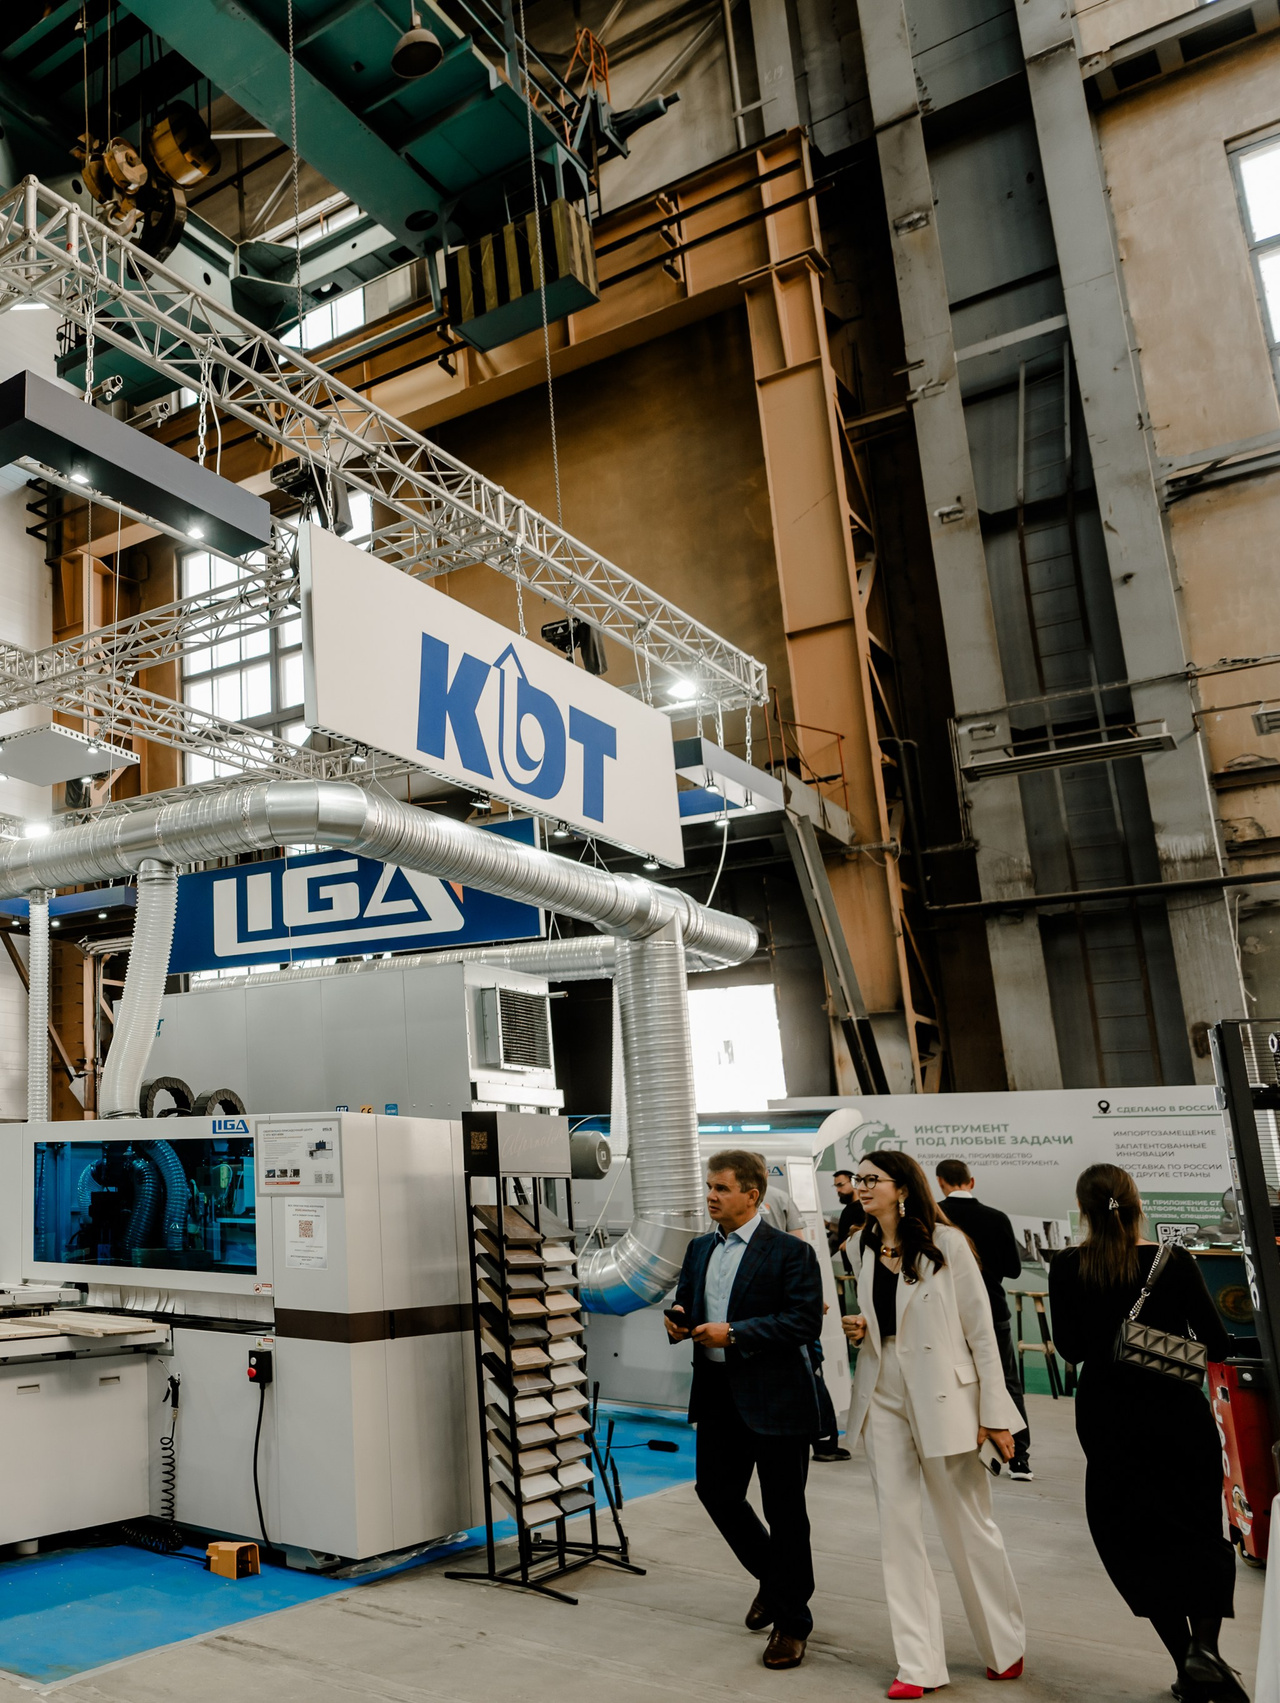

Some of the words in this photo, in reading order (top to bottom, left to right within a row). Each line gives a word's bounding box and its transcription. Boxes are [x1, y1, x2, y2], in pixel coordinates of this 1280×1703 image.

[212, 859, 464, 958] LIGA
[212, 1119, 250, 1134] LIGA
[914, 1123, 1010, 1134] ИНСТРУМЕНТ
[1112, 1129, 1217, 1137] ИМПОРТОЗАМЕЩЕНИЕ
[915, 1136, 947, 1147] ПОД
[950, 1135, 1007, 1146] ЛЮБЫЕ
[1011, 1135, 1074, 1146] ЗАДАЧИ
[1115, 1142, 1207, 1150] ЗАПАТЕНТОВАННЫЕ
[968, 1152, 1033, 1160] ПРОИЗВОДСТВО
